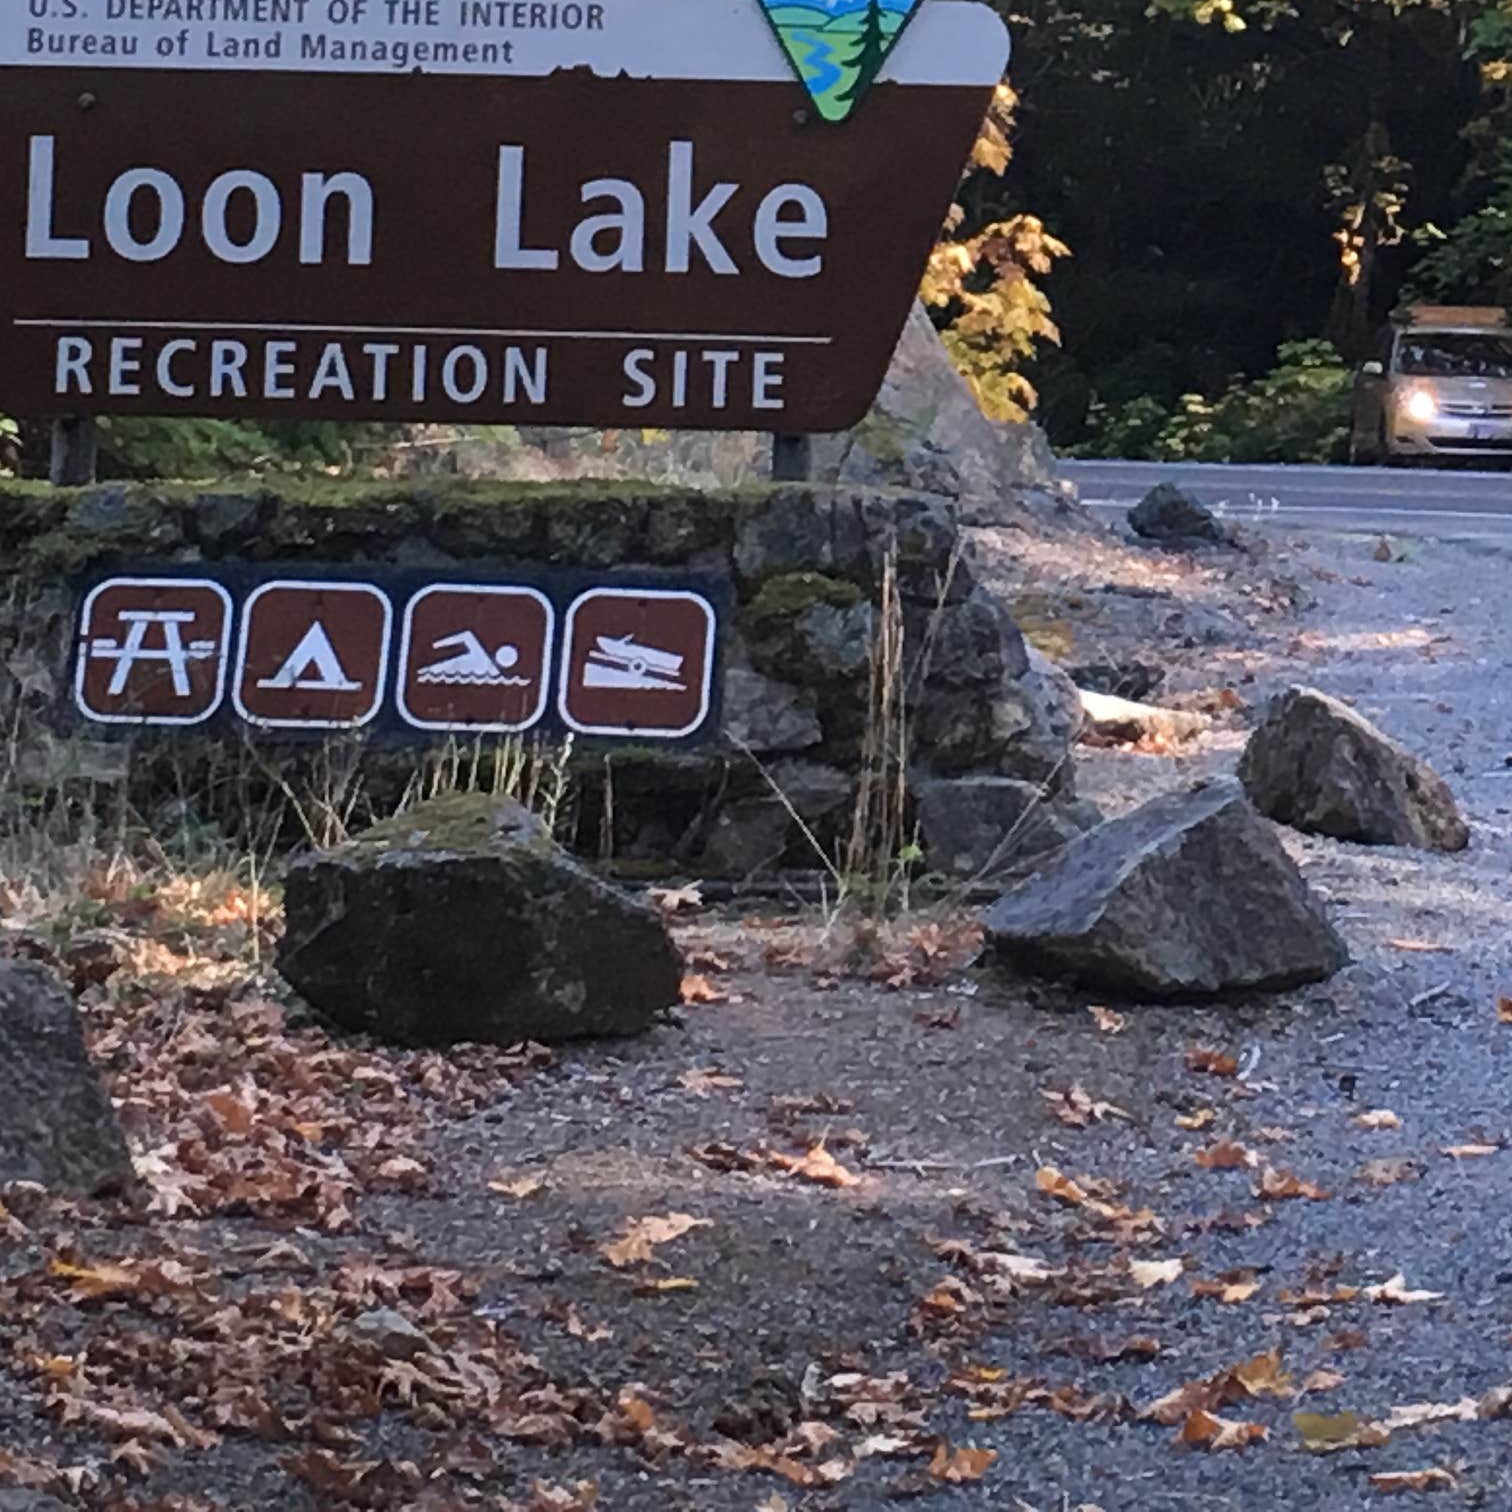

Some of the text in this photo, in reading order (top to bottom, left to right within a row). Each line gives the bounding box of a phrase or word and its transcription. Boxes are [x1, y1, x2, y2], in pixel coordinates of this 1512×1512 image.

[384, 0, 440, 26] THE
[460, 1, 605, 30] INTERIOR
[27, 27, 514, 69] Bureau of Land Management
[25, 135, 829, 278] Loon Lake
[54, 336, 785, 409] RECREATION SITE
